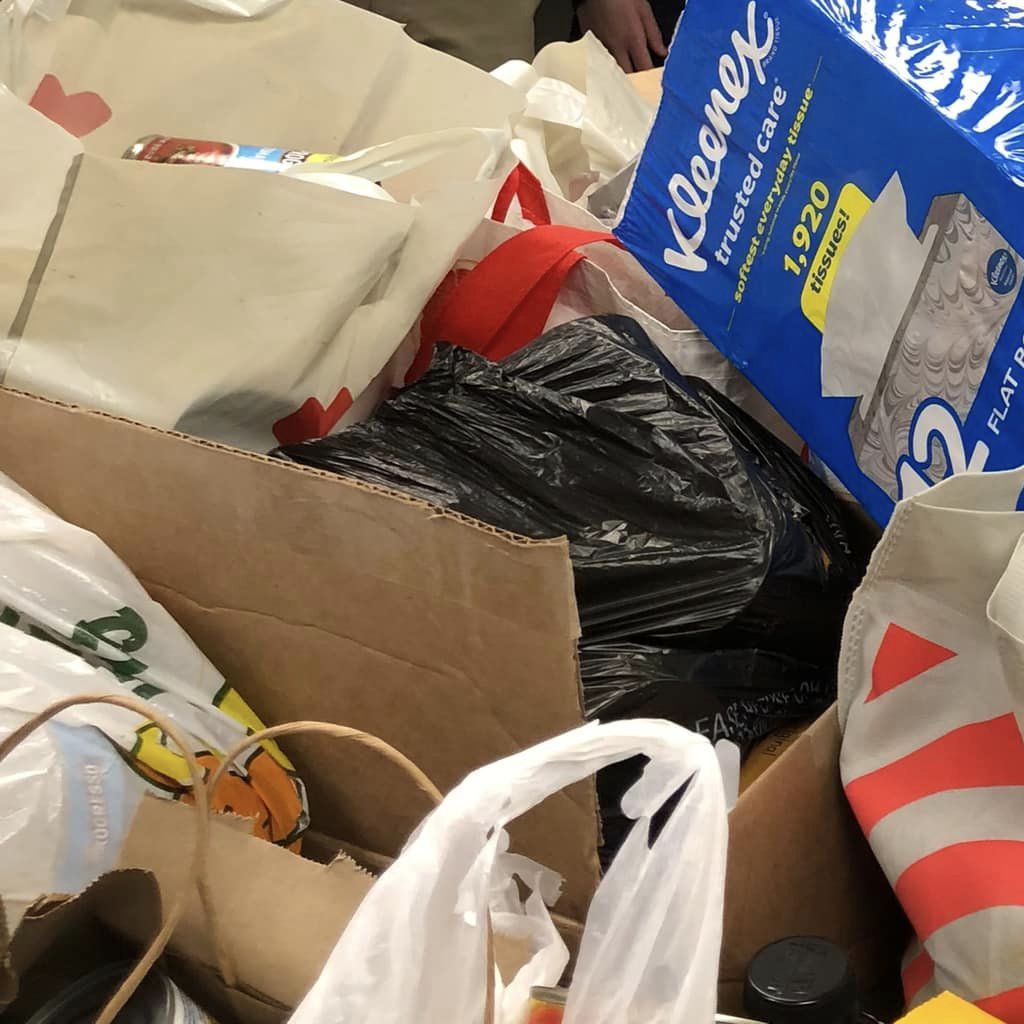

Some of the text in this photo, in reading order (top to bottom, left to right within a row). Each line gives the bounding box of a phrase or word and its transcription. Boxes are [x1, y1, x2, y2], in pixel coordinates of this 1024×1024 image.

[663, 0, 774, 273] Kleenex
[714, 152, 763, 267] trusted
[756, 84, 788, 154] care
[734, 234, 761, 304] softest
[756, 146, 793, 236] everyday
[786, 86, 813, 146] tissue
[783, 179, 831, 278] 1,920
[809, 207, 851, 295] tissues!
[986, 367, 1019, 435] FLAT
